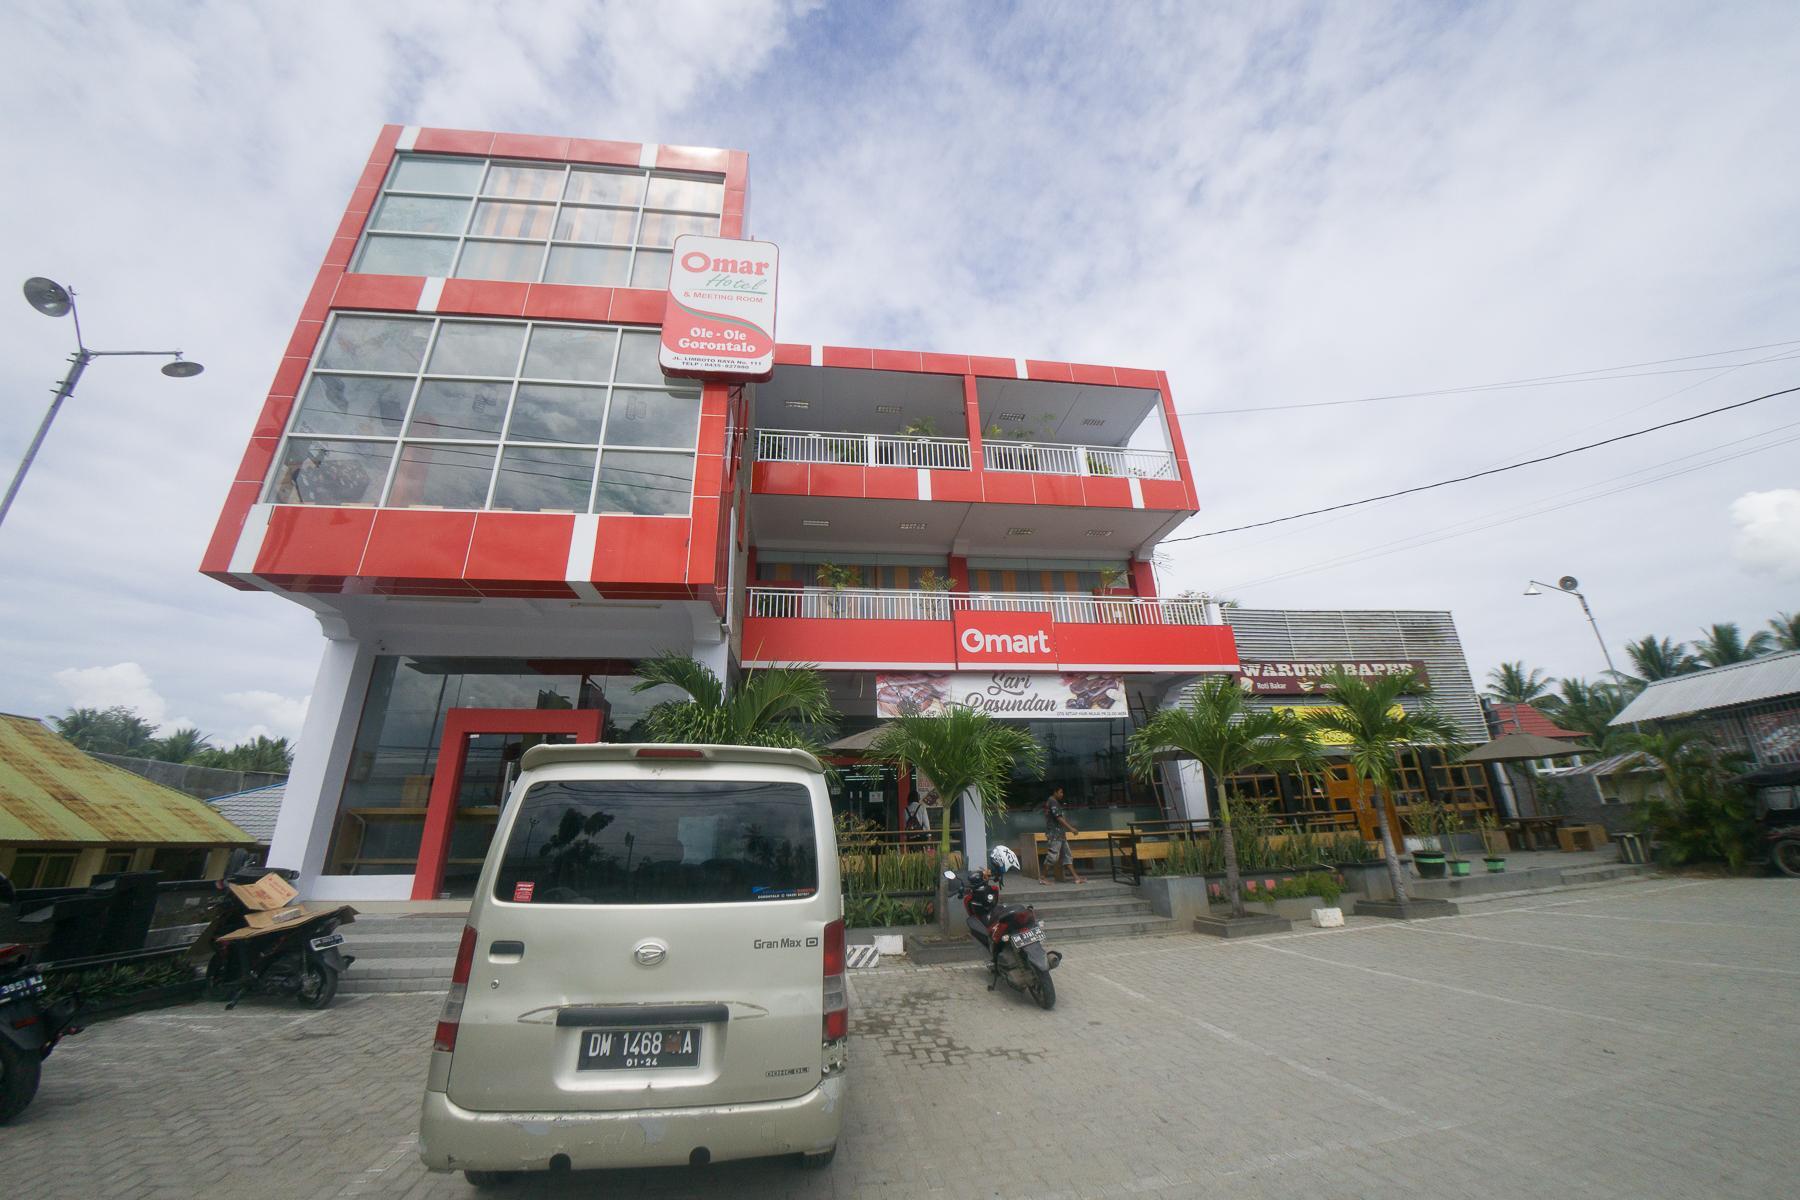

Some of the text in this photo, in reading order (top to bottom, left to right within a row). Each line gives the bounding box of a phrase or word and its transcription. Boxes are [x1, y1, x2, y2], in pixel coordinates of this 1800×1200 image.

[681, 251, 770, 276] Omar
[705, 273, 768, 290] Hotel
[693, 291, 734, 301] MEETING
[736, 295, 763, 303] ROOM
[690, 327, 714, 338] Ole
[723, 329, 747, 341] Ole
[678, 337, 756, 353] Gorontalo
[961, 627, 1051, 654] Omart
[987, 671, 1032, 696] Sari
[944, 692, 1057, 717] Pasundan
[753, 937, 802, 950] Gran Max
[588, 1033, 613, 1057] DM
[622, 1031, 663, 1056] 1468
